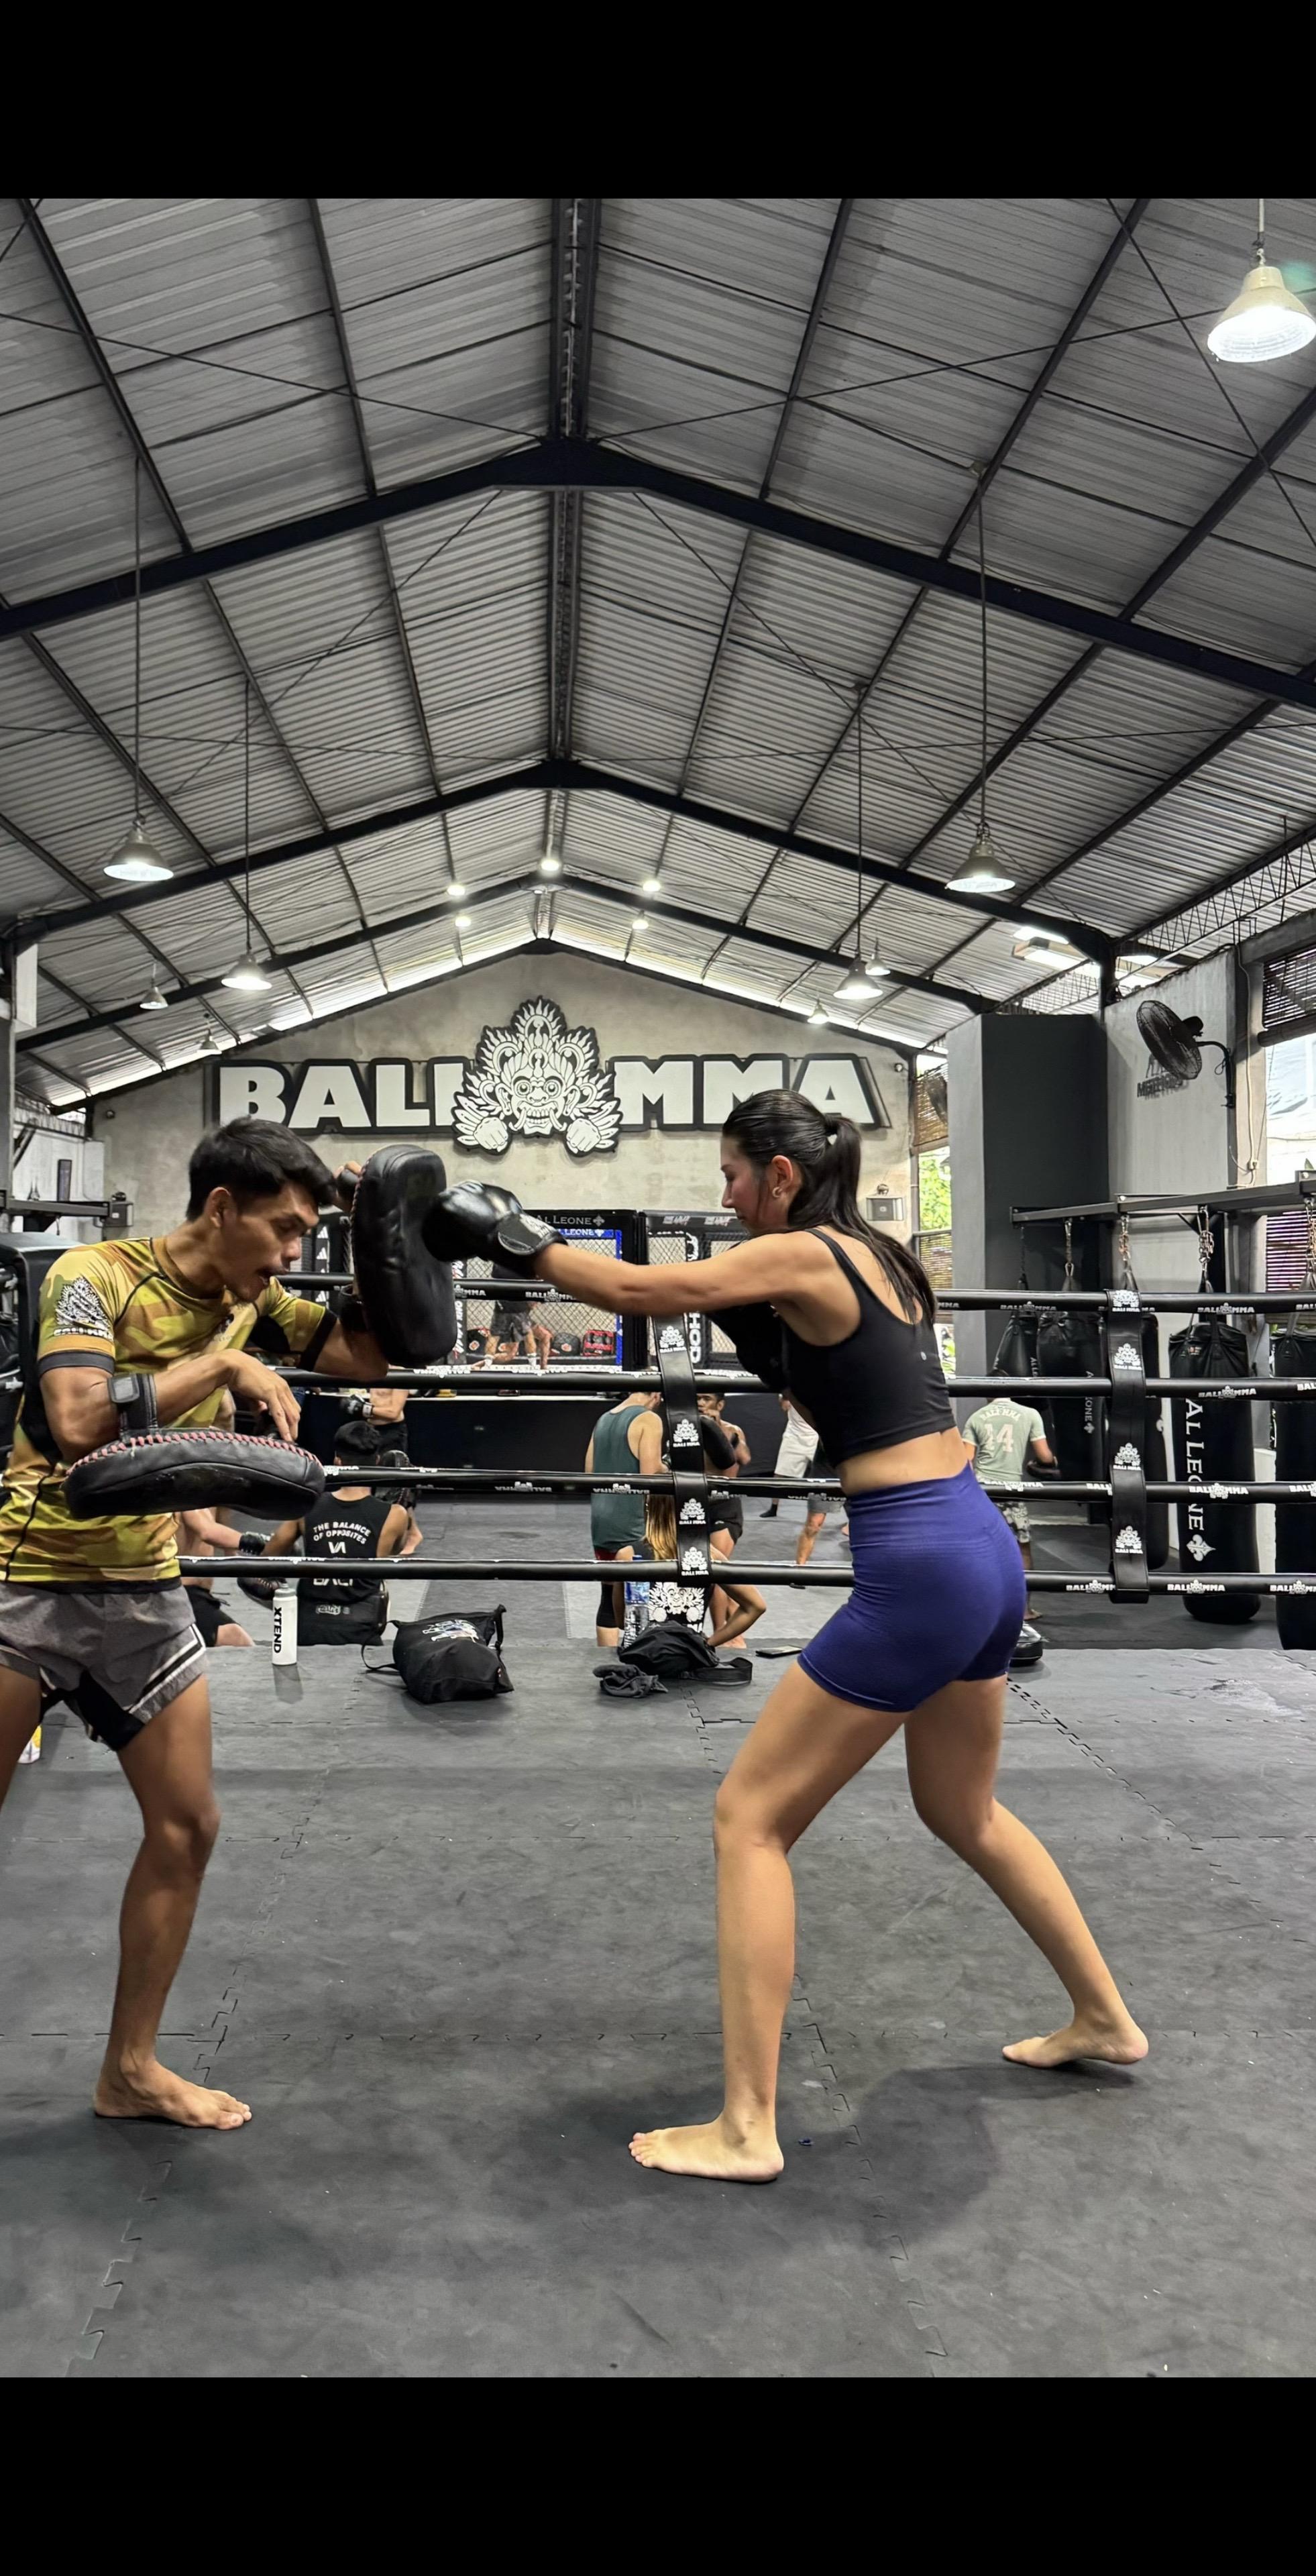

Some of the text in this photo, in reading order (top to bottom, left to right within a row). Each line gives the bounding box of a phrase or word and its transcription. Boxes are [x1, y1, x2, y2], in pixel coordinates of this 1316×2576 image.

[219, 1060, 875, 1128] BALI MMA
[553, 1215, 592, 1226] LEONE
[1233, 1388, 1256, 1396] MMA
[1185, 1398, 1203, 1435] AL
[984, 1424, 1014, 1452] 14
[1189, 1485, 1249, 1495] BALI MMA
[1288, 1485, 1311, 1493] BALI
[313, 1521, 372, 1537] THE BALANCE
[313, 1529, 367, 1544] OF OPPOSITES
[1202, 1584, 1225, 1592] MMA
[274, 1607, 282, 1653] XTEND
